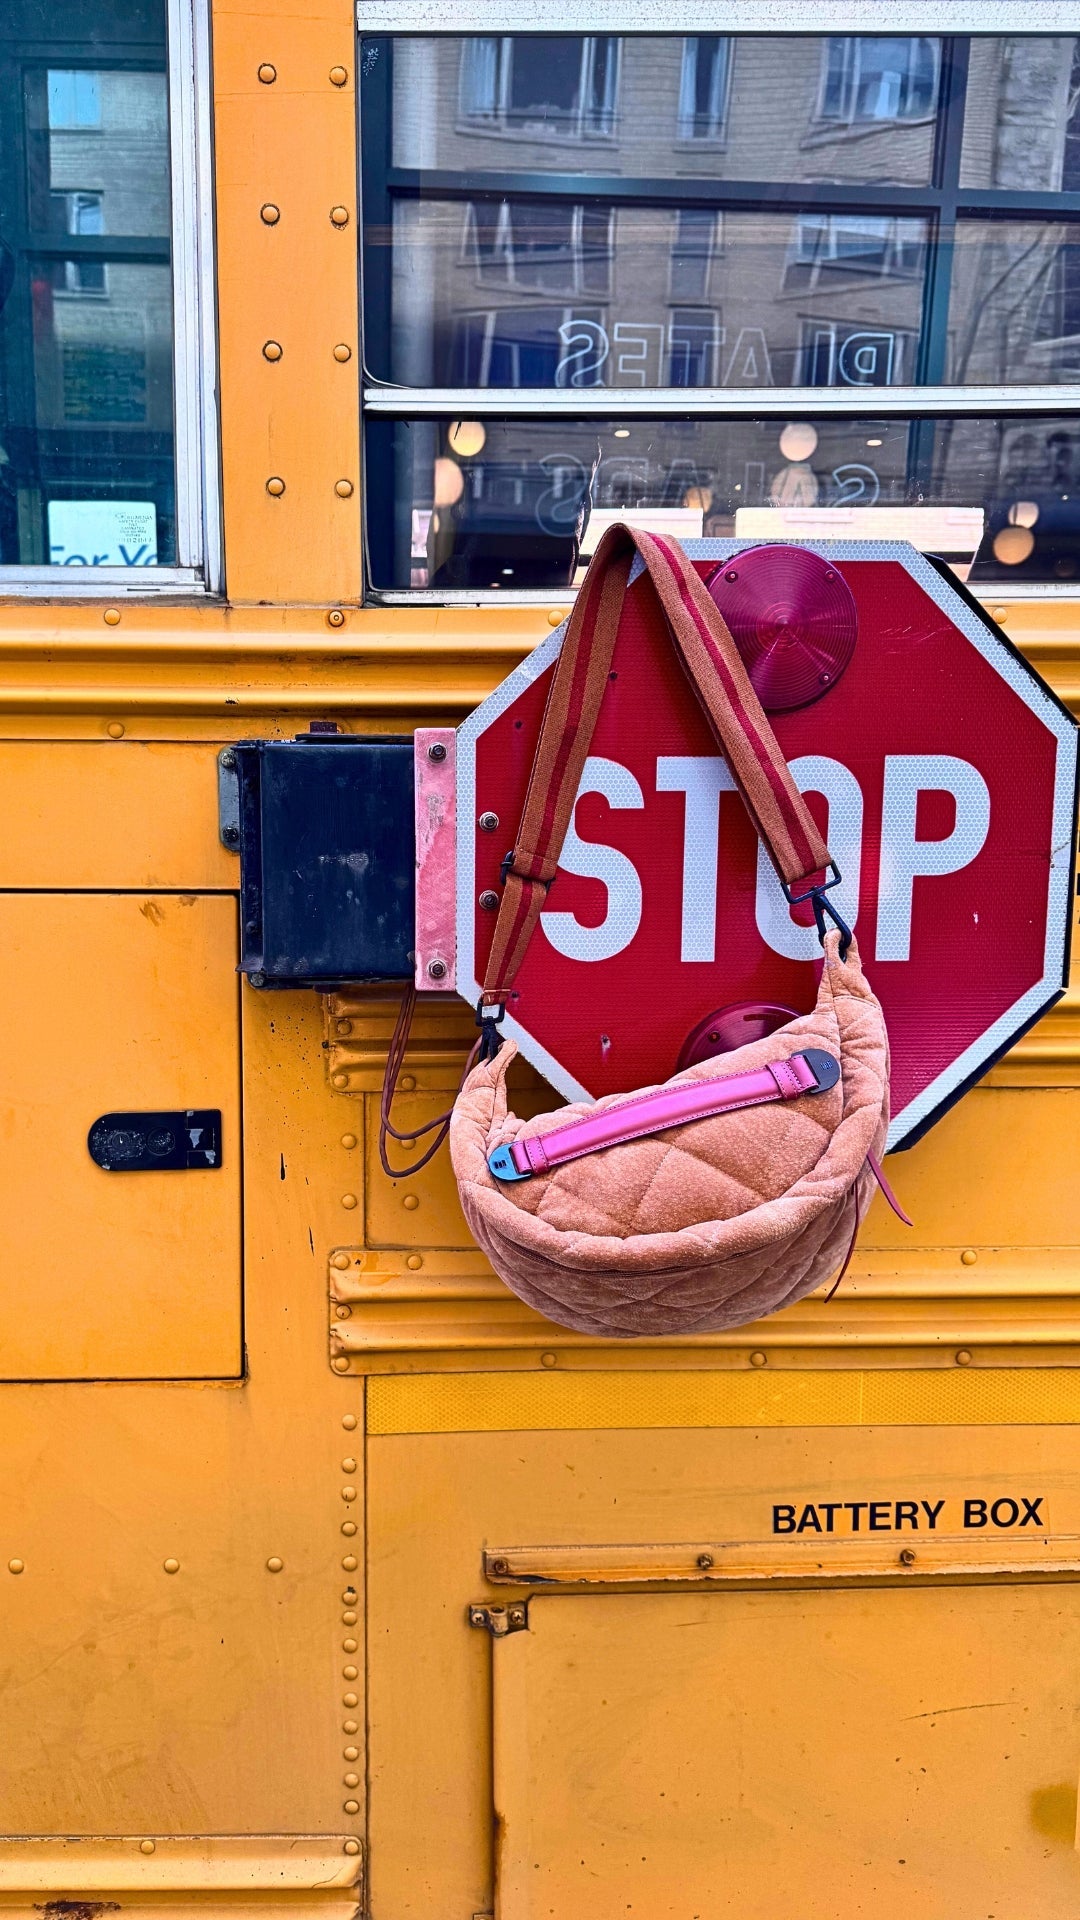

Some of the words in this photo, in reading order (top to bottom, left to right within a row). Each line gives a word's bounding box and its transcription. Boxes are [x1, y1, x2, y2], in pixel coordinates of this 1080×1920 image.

[540, 754, 991, 963] STOP
[772, 1500, 946, 1534] BATTERY
[963, 1497, 1044, 1529] BOX
